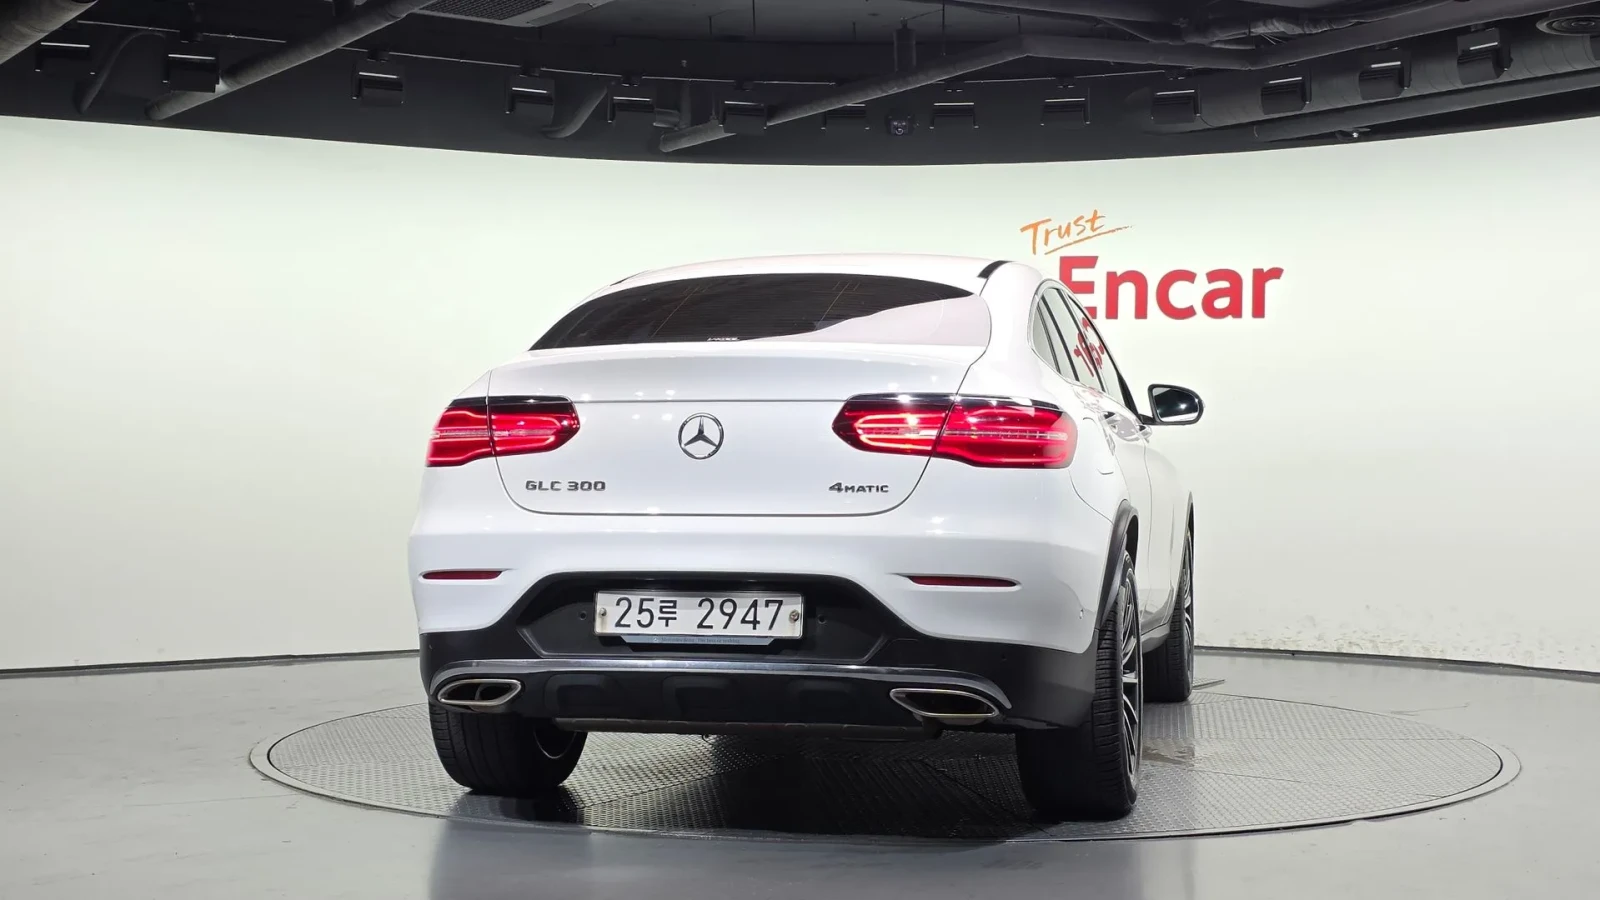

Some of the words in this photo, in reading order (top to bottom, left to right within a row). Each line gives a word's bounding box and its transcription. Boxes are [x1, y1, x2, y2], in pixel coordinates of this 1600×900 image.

[1020, 209, 1106, 255] Trust
[1059, 256, 1284, 320] Encar
[525, 480, 562, 491] GLC
[567, 480, 606, 492] 300
[828, 482, 889, 493] 4MATIC
[614, 597, 677, 628] 25루
[697, 598, 783, 631] 2947
